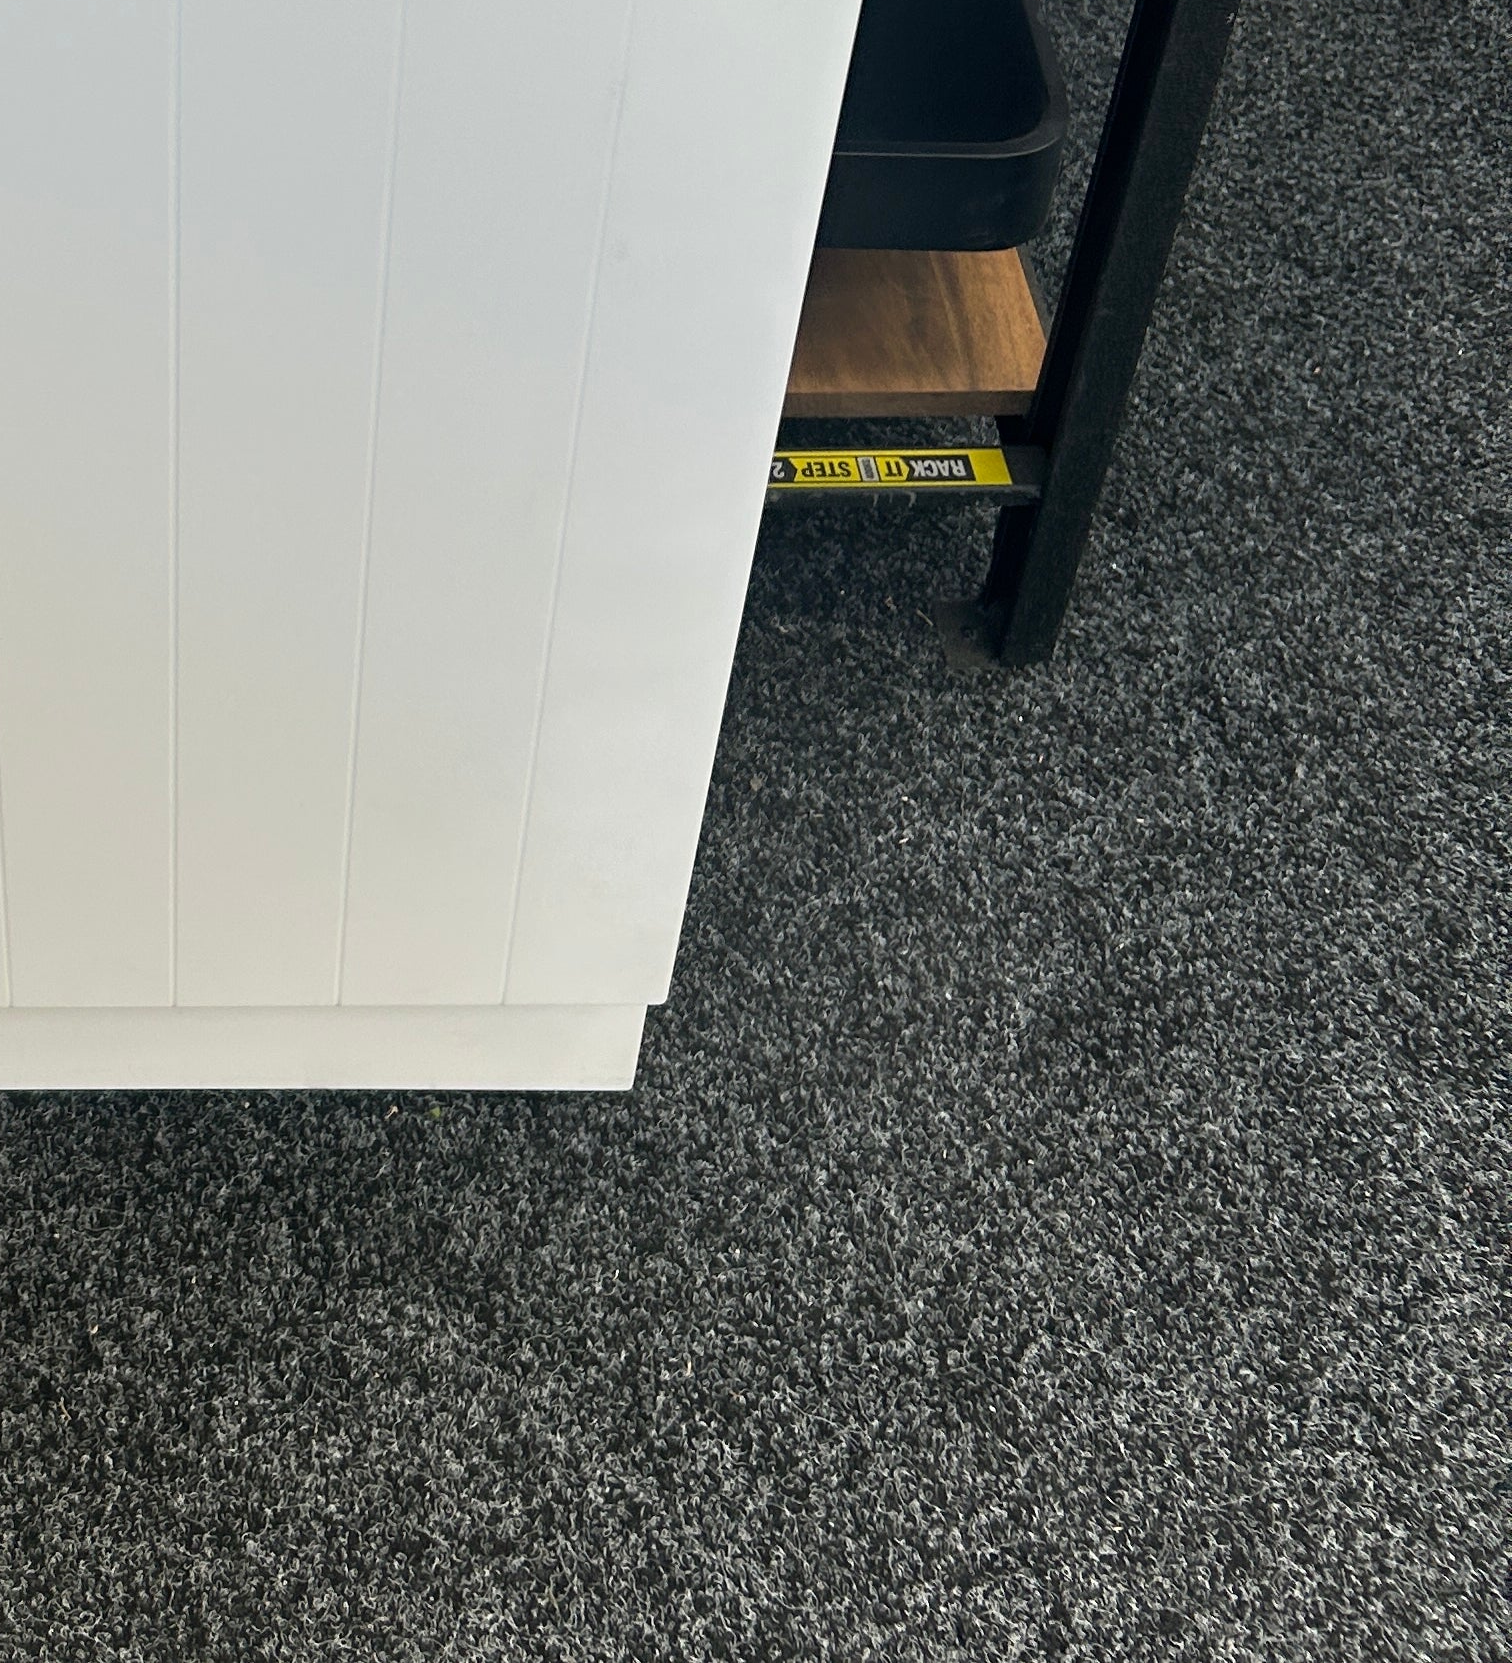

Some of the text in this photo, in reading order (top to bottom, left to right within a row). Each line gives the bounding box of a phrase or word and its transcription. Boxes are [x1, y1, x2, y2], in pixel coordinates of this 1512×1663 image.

[801, 461, 852, 478] STEP
[885, 460, 903, 477] IT
[909, 458, 967, 478] RACK
